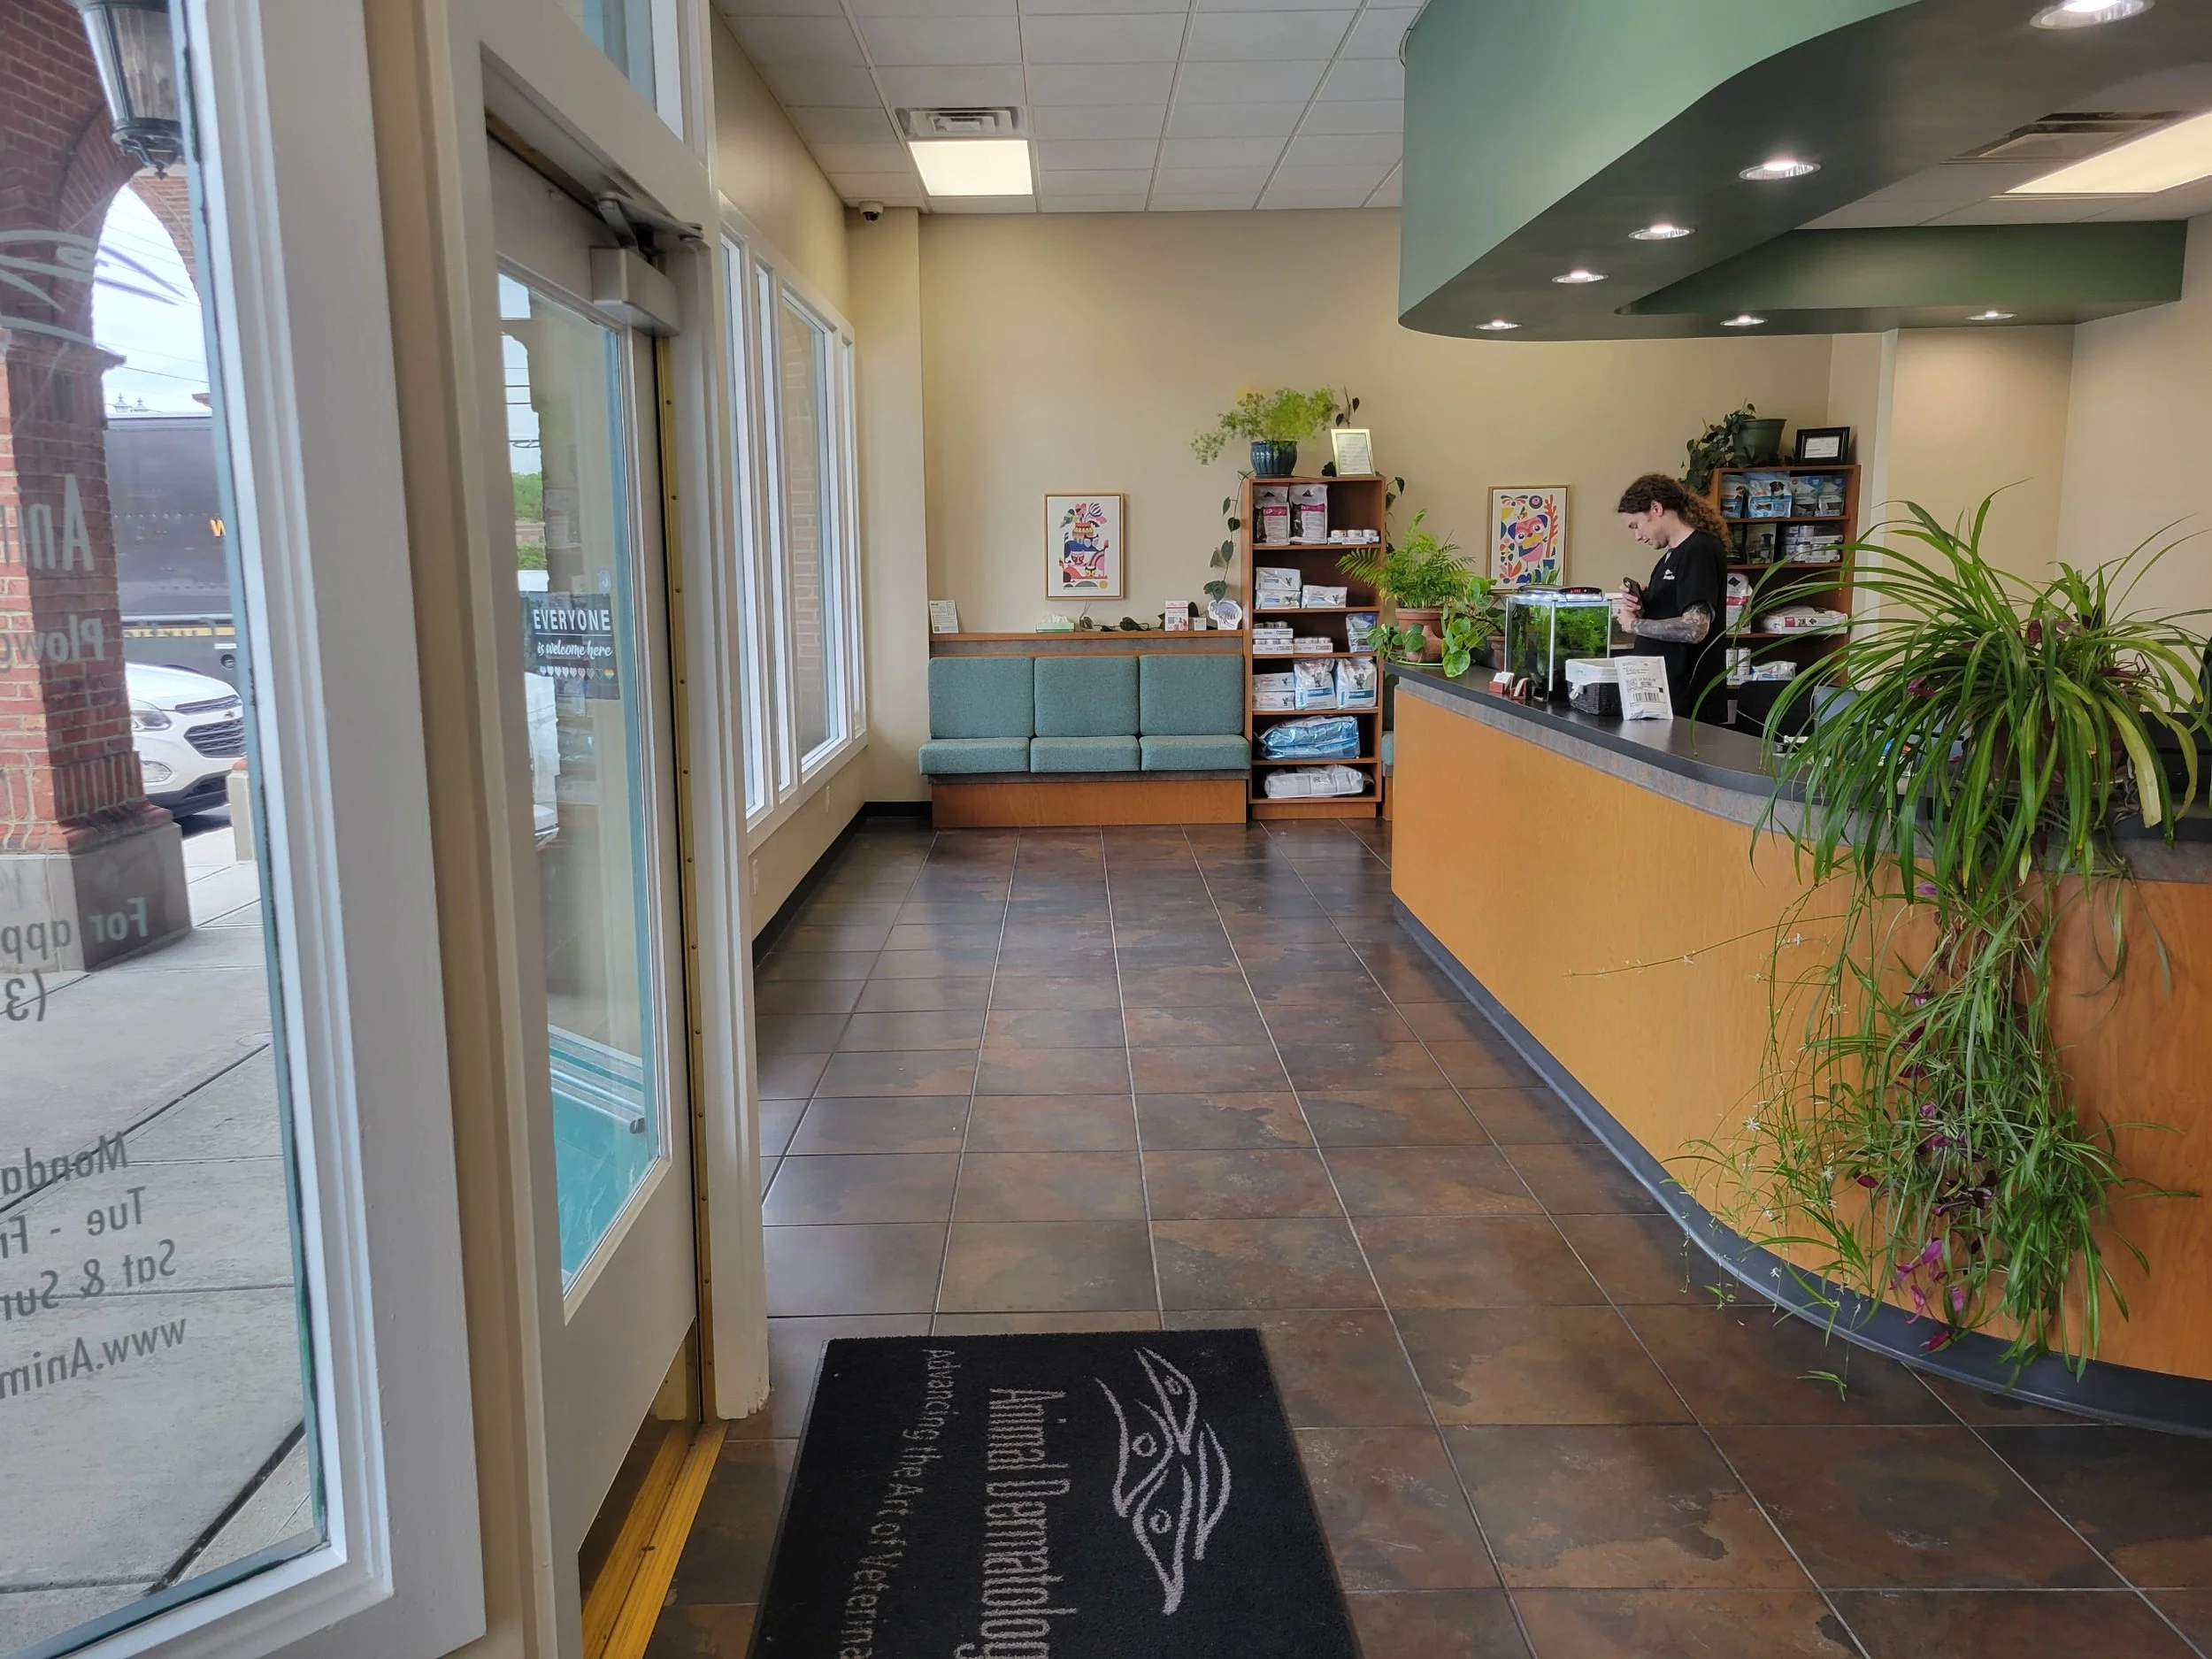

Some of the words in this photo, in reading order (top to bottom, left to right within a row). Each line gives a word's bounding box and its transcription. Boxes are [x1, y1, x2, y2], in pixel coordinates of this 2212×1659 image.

[533, 609, 611, 631] EVERYONE
[537, 641, 545, 657] is
[546, 639, 587, 658] welcome
[587, 640, 613, 659] here
[902, 1348, 962, 1441] Advancing
[987, 1387, 1068, 1471] Animal
[892, 1446, 943, 1479] the
[876, 1483, 925, 1516] Art
[867, 1522, 908, 1548] of
